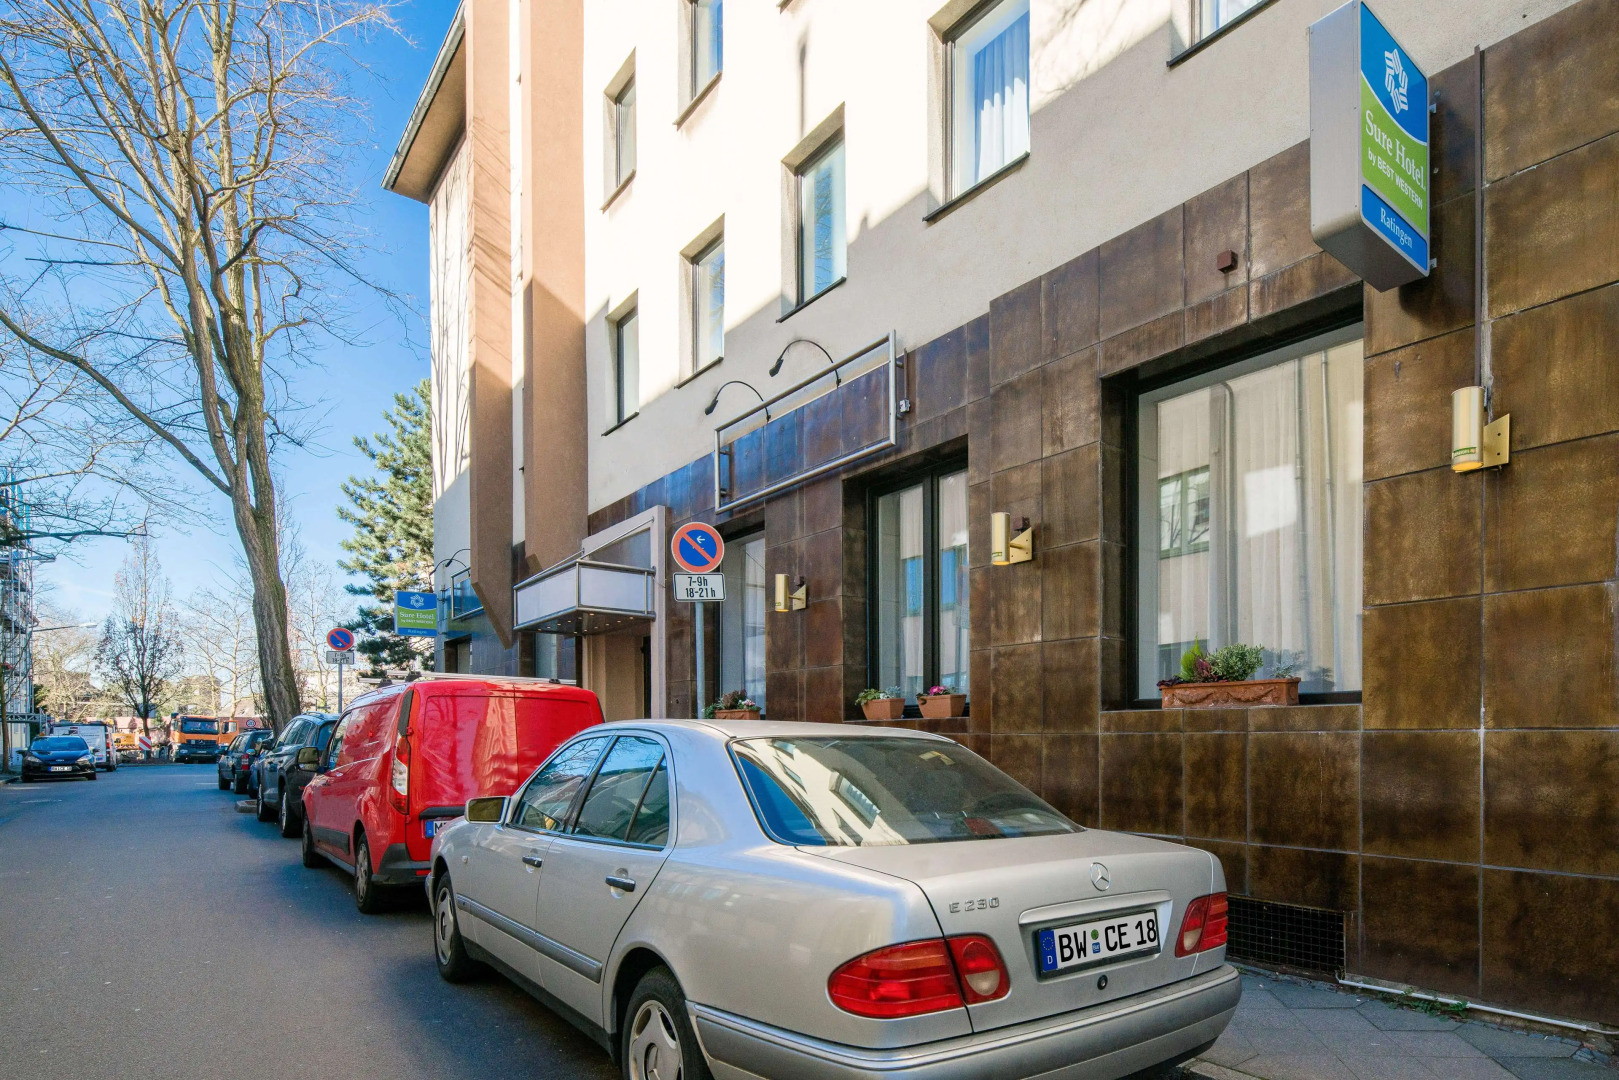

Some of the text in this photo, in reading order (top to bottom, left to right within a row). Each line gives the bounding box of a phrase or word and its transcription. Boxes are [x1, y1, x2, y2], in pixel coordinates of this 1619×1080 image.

[1365, 109, 1393, 156] Sure
[1368, 147, 1423, 210] by BEST WESTERN
[1380, 207, 1413, 248] Ratingen
[416, 612, 434, 620] Hotel
[949, 897, 999, 913] E 230
[1047, 955, 1053, 964] D
[1058, 918, 1157, 962] BW CE 18
